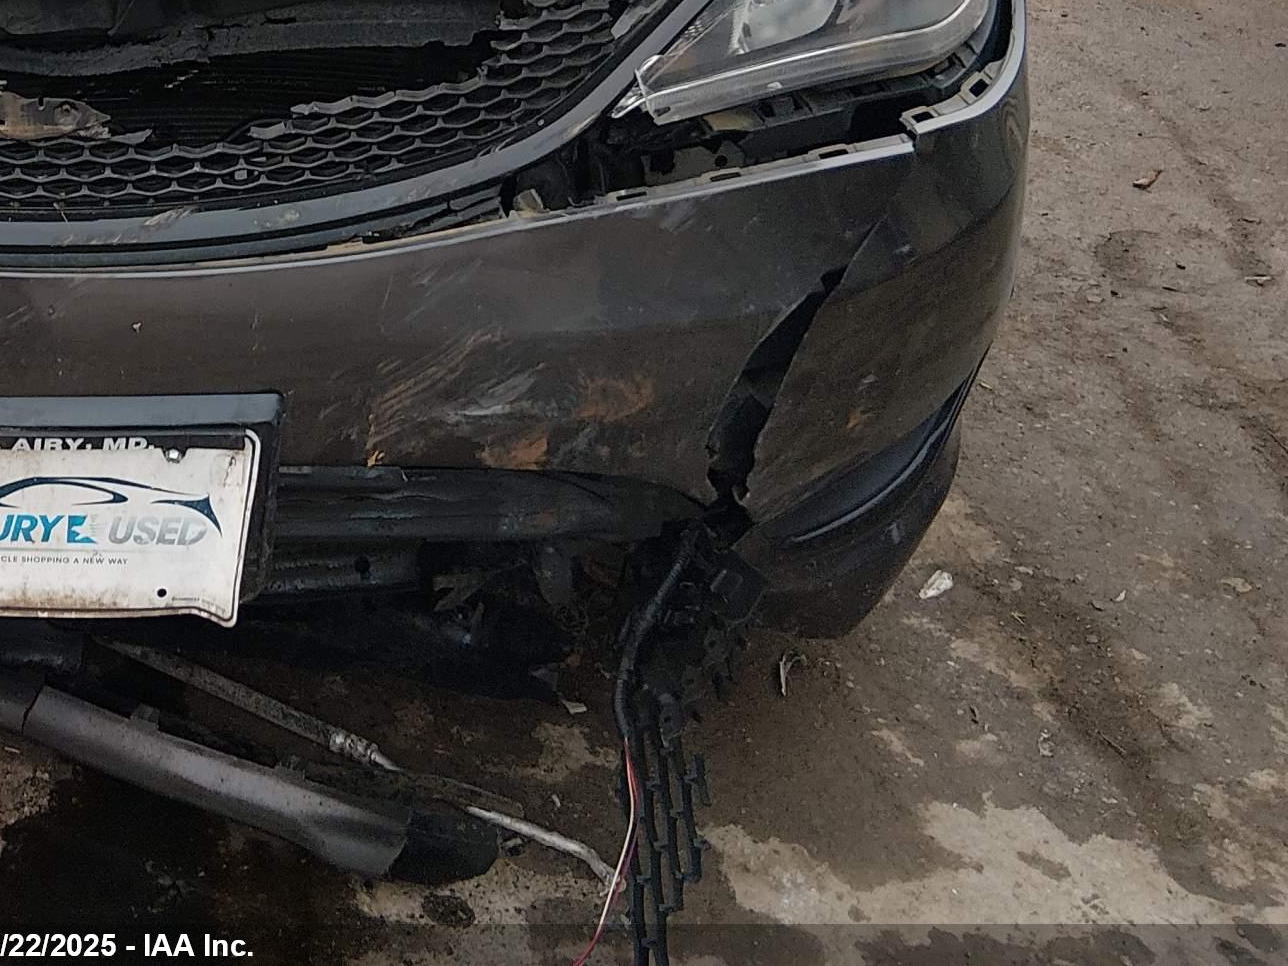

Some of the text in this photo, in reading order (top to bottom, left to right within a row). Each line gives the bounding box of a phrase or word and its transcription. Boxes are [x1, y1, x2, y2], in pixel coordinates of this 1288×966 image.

[107, 513, 208, 547] USED
[21, 555, 70, 565] SHOPPING
[73, 557, 80, 565] A
[83, 557, 104, 565] NEW
[108, 557, 128, 566] WAY
